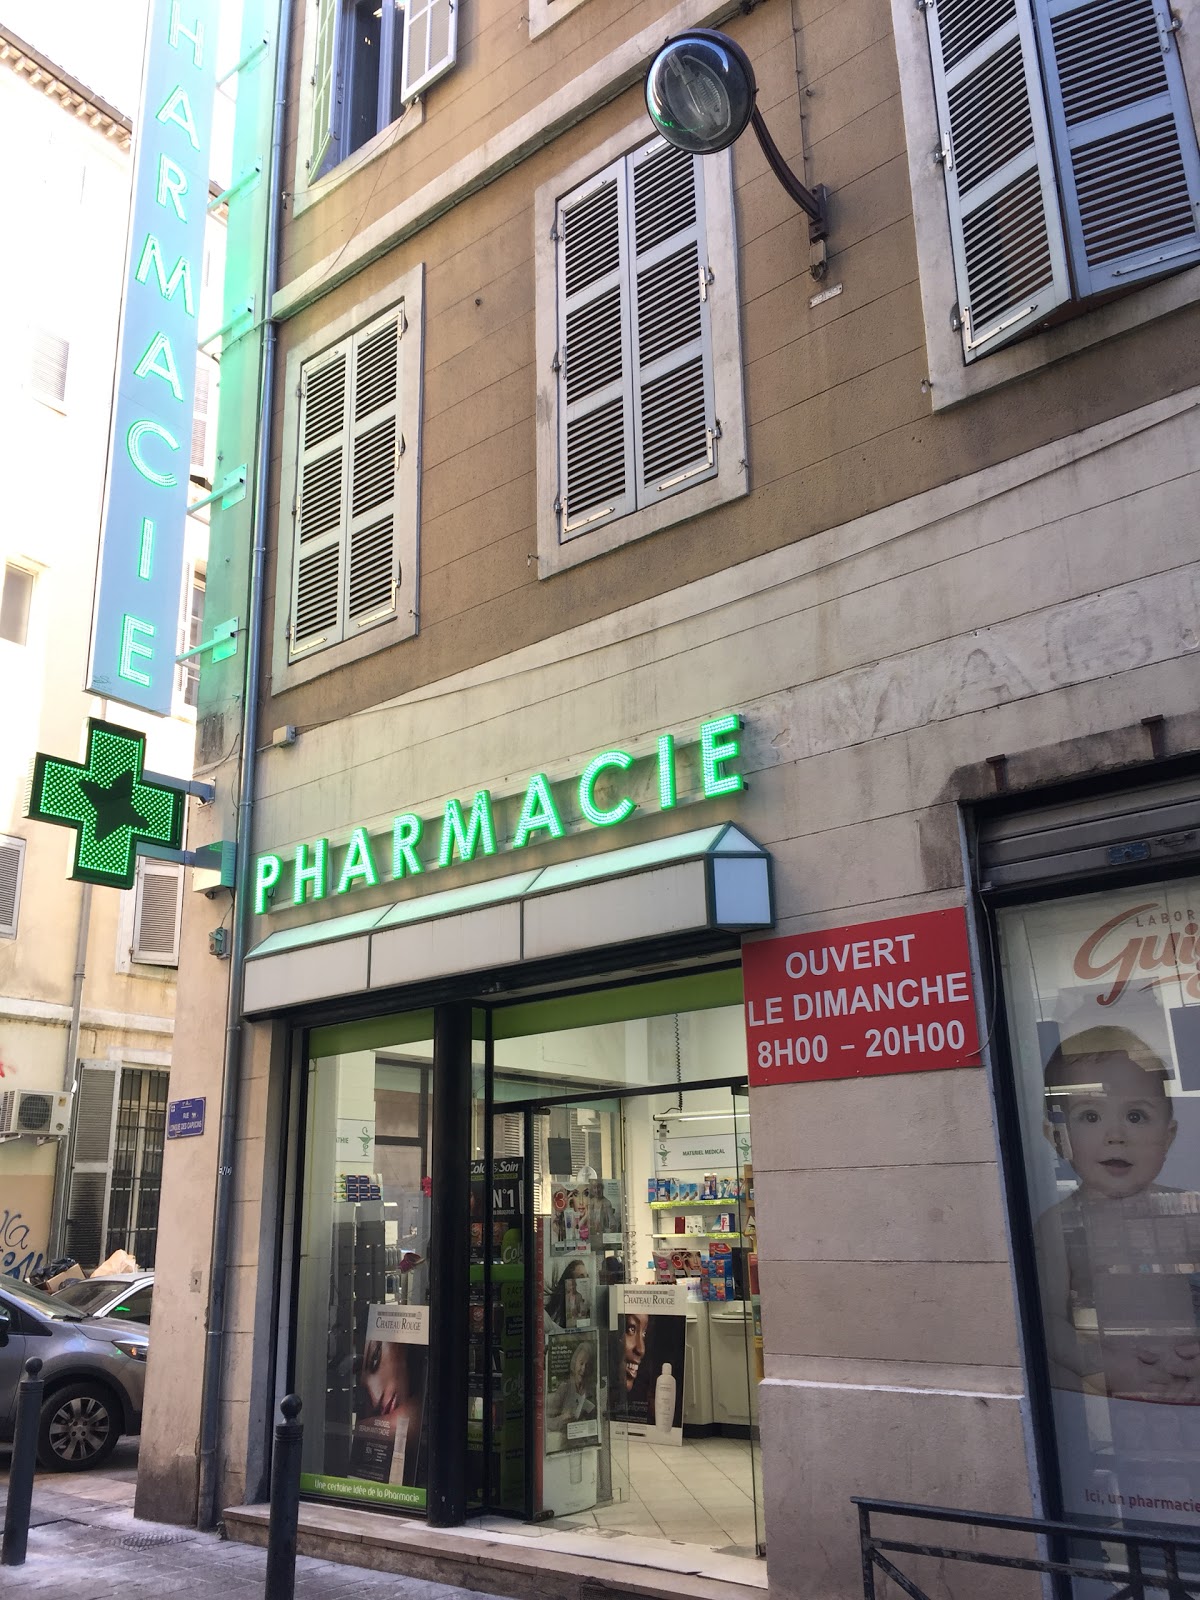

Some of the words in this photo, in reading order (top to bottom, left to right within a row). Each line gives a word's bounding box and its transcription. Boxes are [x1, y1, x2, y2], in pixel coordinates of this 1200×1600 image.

[254, 713, 744, 915] PHARMACIE
[785, 933, 916, 979] OUVERT
[1073, 902, 1200, 1006] Gui
[748, 996, 784, 1027] LE
[793, 971, 969, 1022] DIMANCHE
[757, 1034, 829, 1069] 8H00
[864, 1019, 965, 1058] 20H00
[499, 1161, 519, 1172] Soin
[624, 1294, 652, 1305] CHATEAU
[652, 1294, 675, 1305] ROUGE
[375, 1316, 400, 1329] CHATEAU
[401, 1317, 422, 1331] ROUGE
[314, 1479, 326, 1489] Une
[327, 1481, 353, 1494] certaine
[367, 1487, 376, 1496] de
[376, 1489, 384, 1498] la
[384, 1488, 420, 1503] Pharmacie
[1084, 1488, 1105, 1505] Ici,
[1107, 1493, 1126, 1506] un
